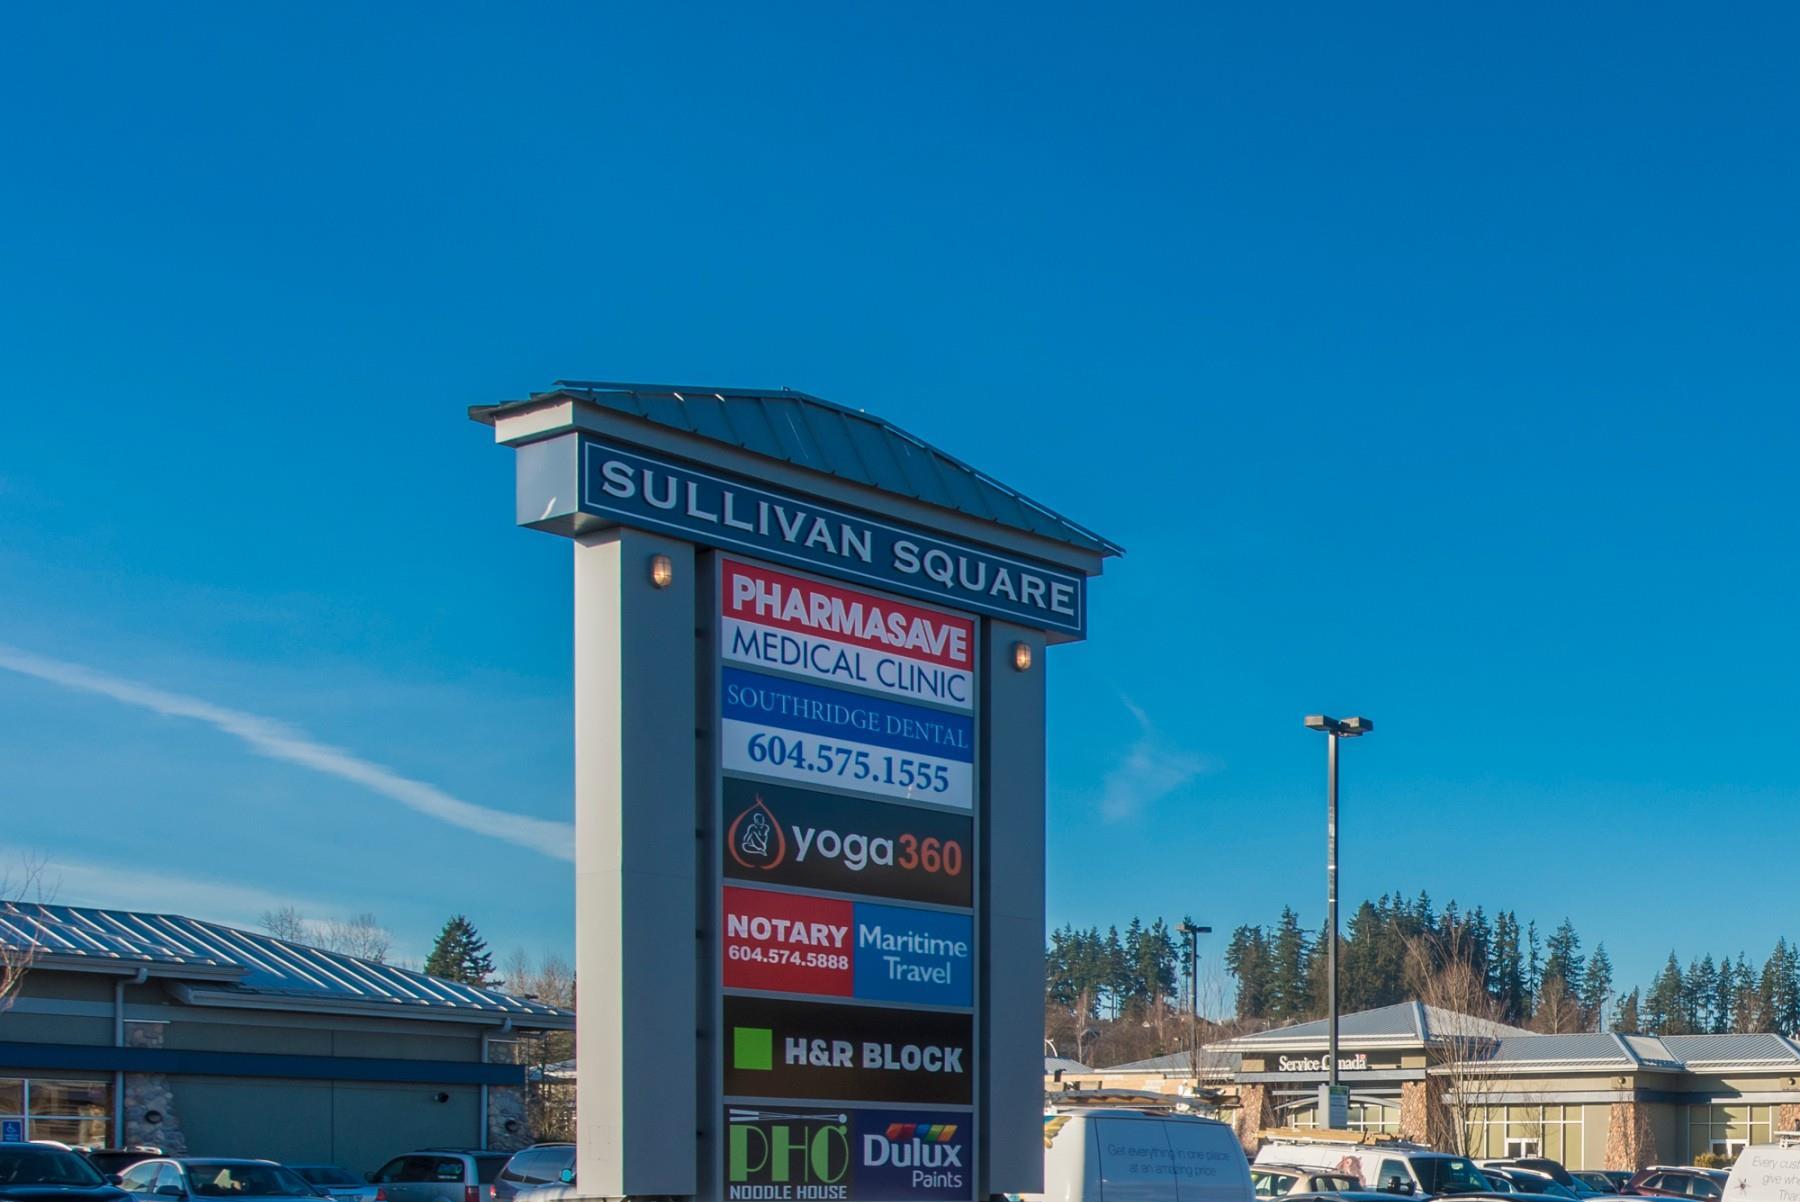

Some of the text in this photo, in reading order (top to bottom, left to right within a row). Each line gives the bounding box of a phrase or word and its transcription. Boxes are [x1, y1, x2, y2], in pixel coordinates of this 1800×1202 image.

[601, 459, 1074, 616] SULLIVAN SQUARE
[732, 573, 967, 662] PHARMASAVE
[732, 624, 966, 703] MEDICAL CLINIC
[728, 683, 968, 749] SOUTHRIDGE DENTAL
[747, 733, 949, 793] 604.575.1555
[728, 914, 848, 948] NOTARY
[859, 925, 968, 958] Maritime
[728, 946, 849, 971] 604.574.5888
[883, 956, 952, 985] Travel
[785, 1038, 963, 1073] H&R BLOCK
[1279, 1054, 1367, 1071] Service Cnada
[864, 1134, 962, 1168] Dulux
[1752, 1156, 1778, 1169] Every
[730, 1185, 847, 1200] NOODLE HOUSE
[912, 1170, 962, 1188] Paints
[1762, 1174, 1782, 1186] give
